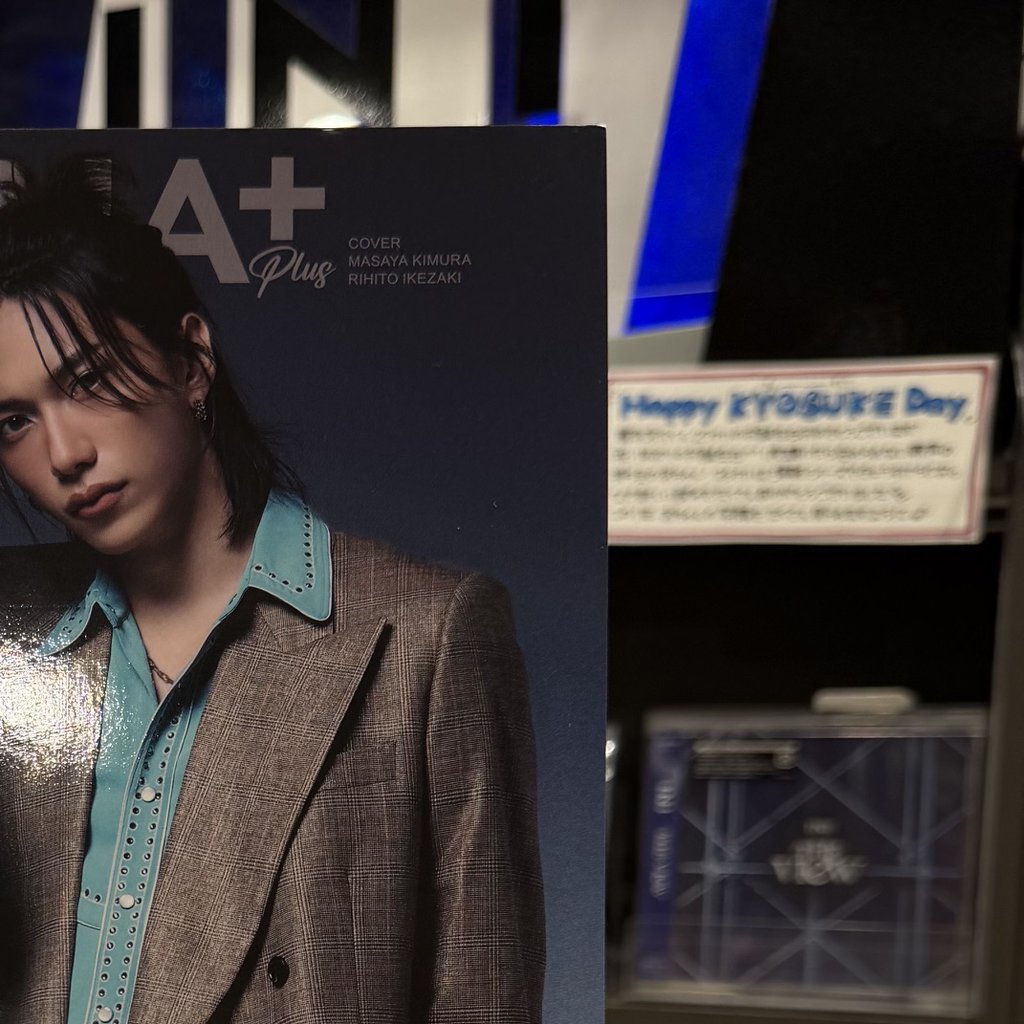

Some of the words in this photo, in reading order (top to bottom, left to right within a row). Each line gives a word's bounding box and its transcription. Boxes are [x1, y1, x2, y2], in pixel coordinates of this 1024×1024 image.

[348, 237, 401, 250] COVER
[348, 255, 409, 267] MASAYA
[412, 253, 472, 266] KIMURA
[249, 245, 336, 299] Plus
[348, 272, 399, 285] RIHITO
[402, 271, 461, 284] IKEZAKI
[619, 394, 718, 426] Happy
[905, 387, 967, 424] Day
